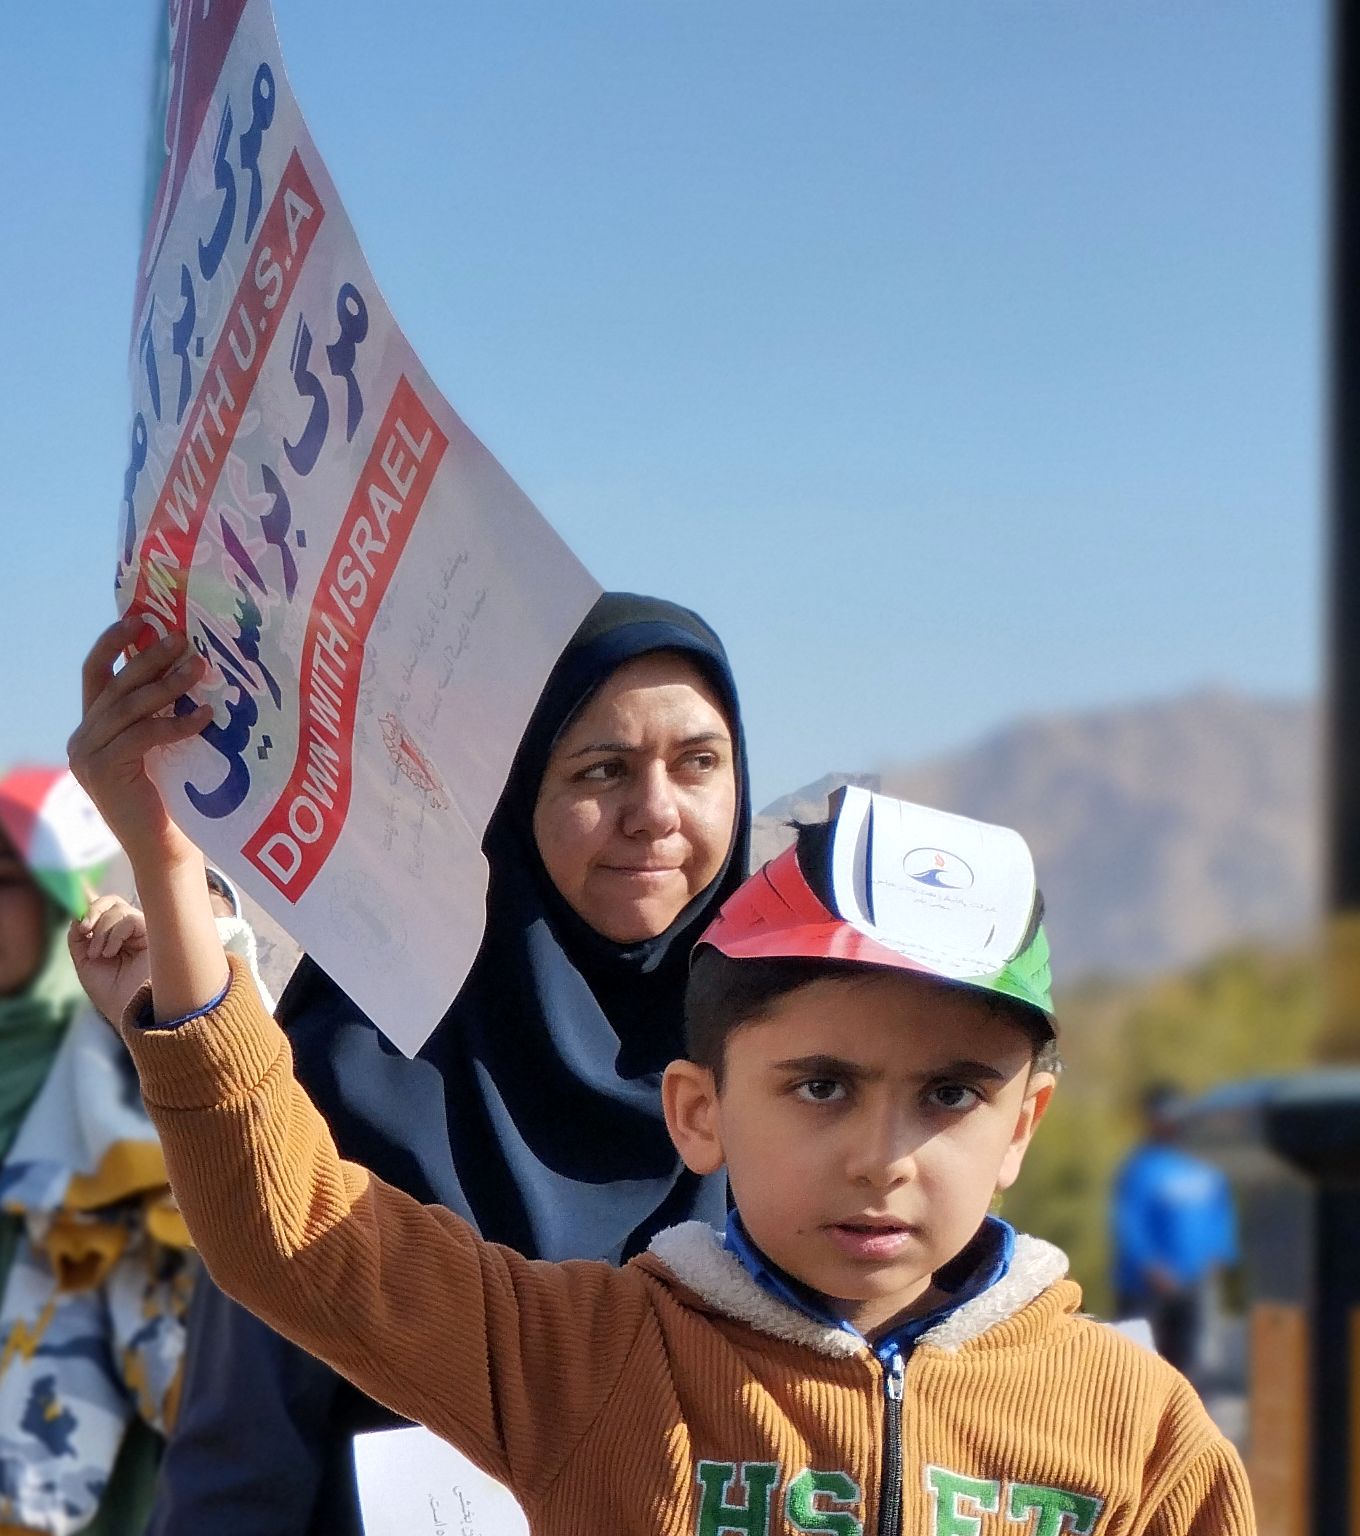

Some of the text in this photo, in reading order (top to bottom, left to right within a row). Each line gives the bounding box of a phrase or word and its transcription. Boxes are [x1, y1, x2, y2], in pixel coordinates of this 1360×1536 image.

[198, 62, 276, 281] مرگ
[164, 376, 237, 535] WITH
[282, 281, 369, 477] مرگ
[260, 462, 308, 604] بر
[256, 726, 341, 886] DOWN
[309, 611, 350, 740] WITH
[334, 415, 434, 627] ISRAEL
